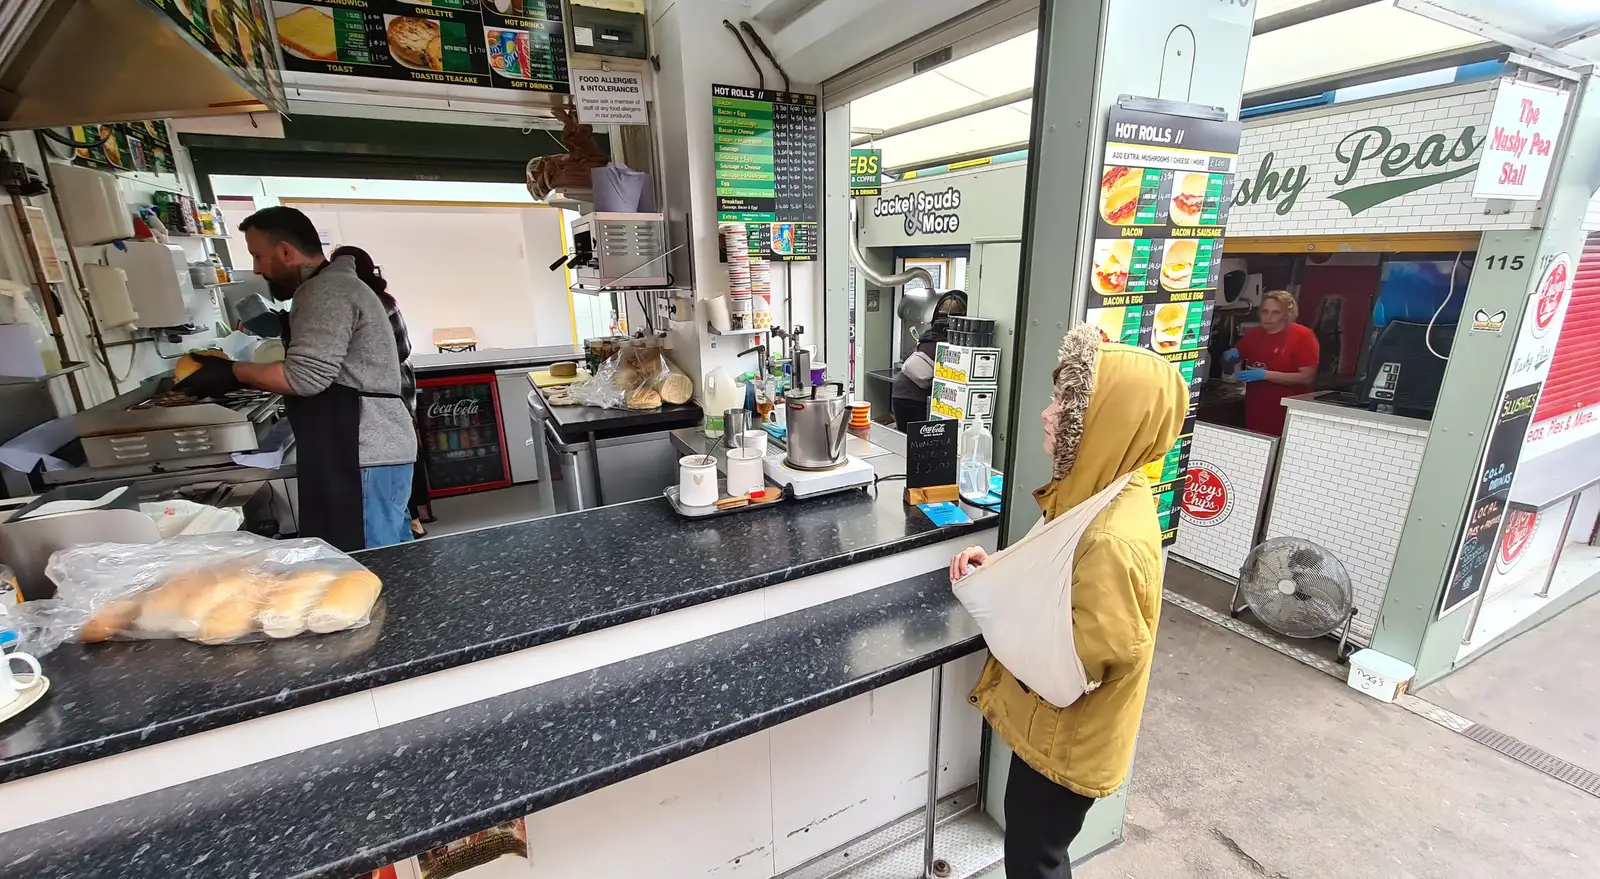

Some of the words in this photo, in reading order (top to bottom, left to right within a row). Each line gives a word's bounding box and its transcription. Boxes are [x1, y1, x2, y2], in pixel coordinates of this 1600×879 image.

[415, 8, 453, 18] OMELETTE
[520, 20, 544, 29] DRINKS
[326, 64, 354, 73] TOAST
[410, 72, 444, 80] TOASTED
[446, 75, 478, 84] TEACAKE
[715, 87, 729, 96] HOT
[731, 88, 754, 98] ROLLS
[1520, 98, 1540, 128] The
[1116, 123, 1138, 139] HOT
[1139, 125, 1171, 142] ROLLS
[1490, 126, 1528, 159] Mushy
[1529, 132, 1551, 156] Pea
[1141, 154, 1170, 162] MUSHROOMS
[1334, 125, 1486, 186] Peas
[1498, 161, 1527, 185] Stall
[874, 193, 914, 216] Jacket
[917, 187, 960, 213] Spuds
[904, 210, 922, 236] &
[922, 214, 959, 234] More
[1122, 228, 1143, 236] BACON
[1171, 228, 1191, 236] BACON
[1197, 228, 1222, 236] SAUSAGE
[1486, 255, 1525, 270] 115
[1103, 297, 1125, 305] BACON
[1131, 296, 1143, 304] EGG
[1170, 293, 1192, 301] DOUBLE
[427, 398, 480, 426] Coca-Cola
[1501, 393, 1537, 417] SLUSHIES
[920, 424, 945, 434] Coca-Cola
[1547, 419, 1563, 437] Pies
[1564, 416, 1572, 430] &
[1483, 463, 1505, 482] COLD
[1488, 472, 1512, 491] DRINKS
[1183, 491, 1215, 509] Chips
[1472, 501, 1498, 523] LOCAL
